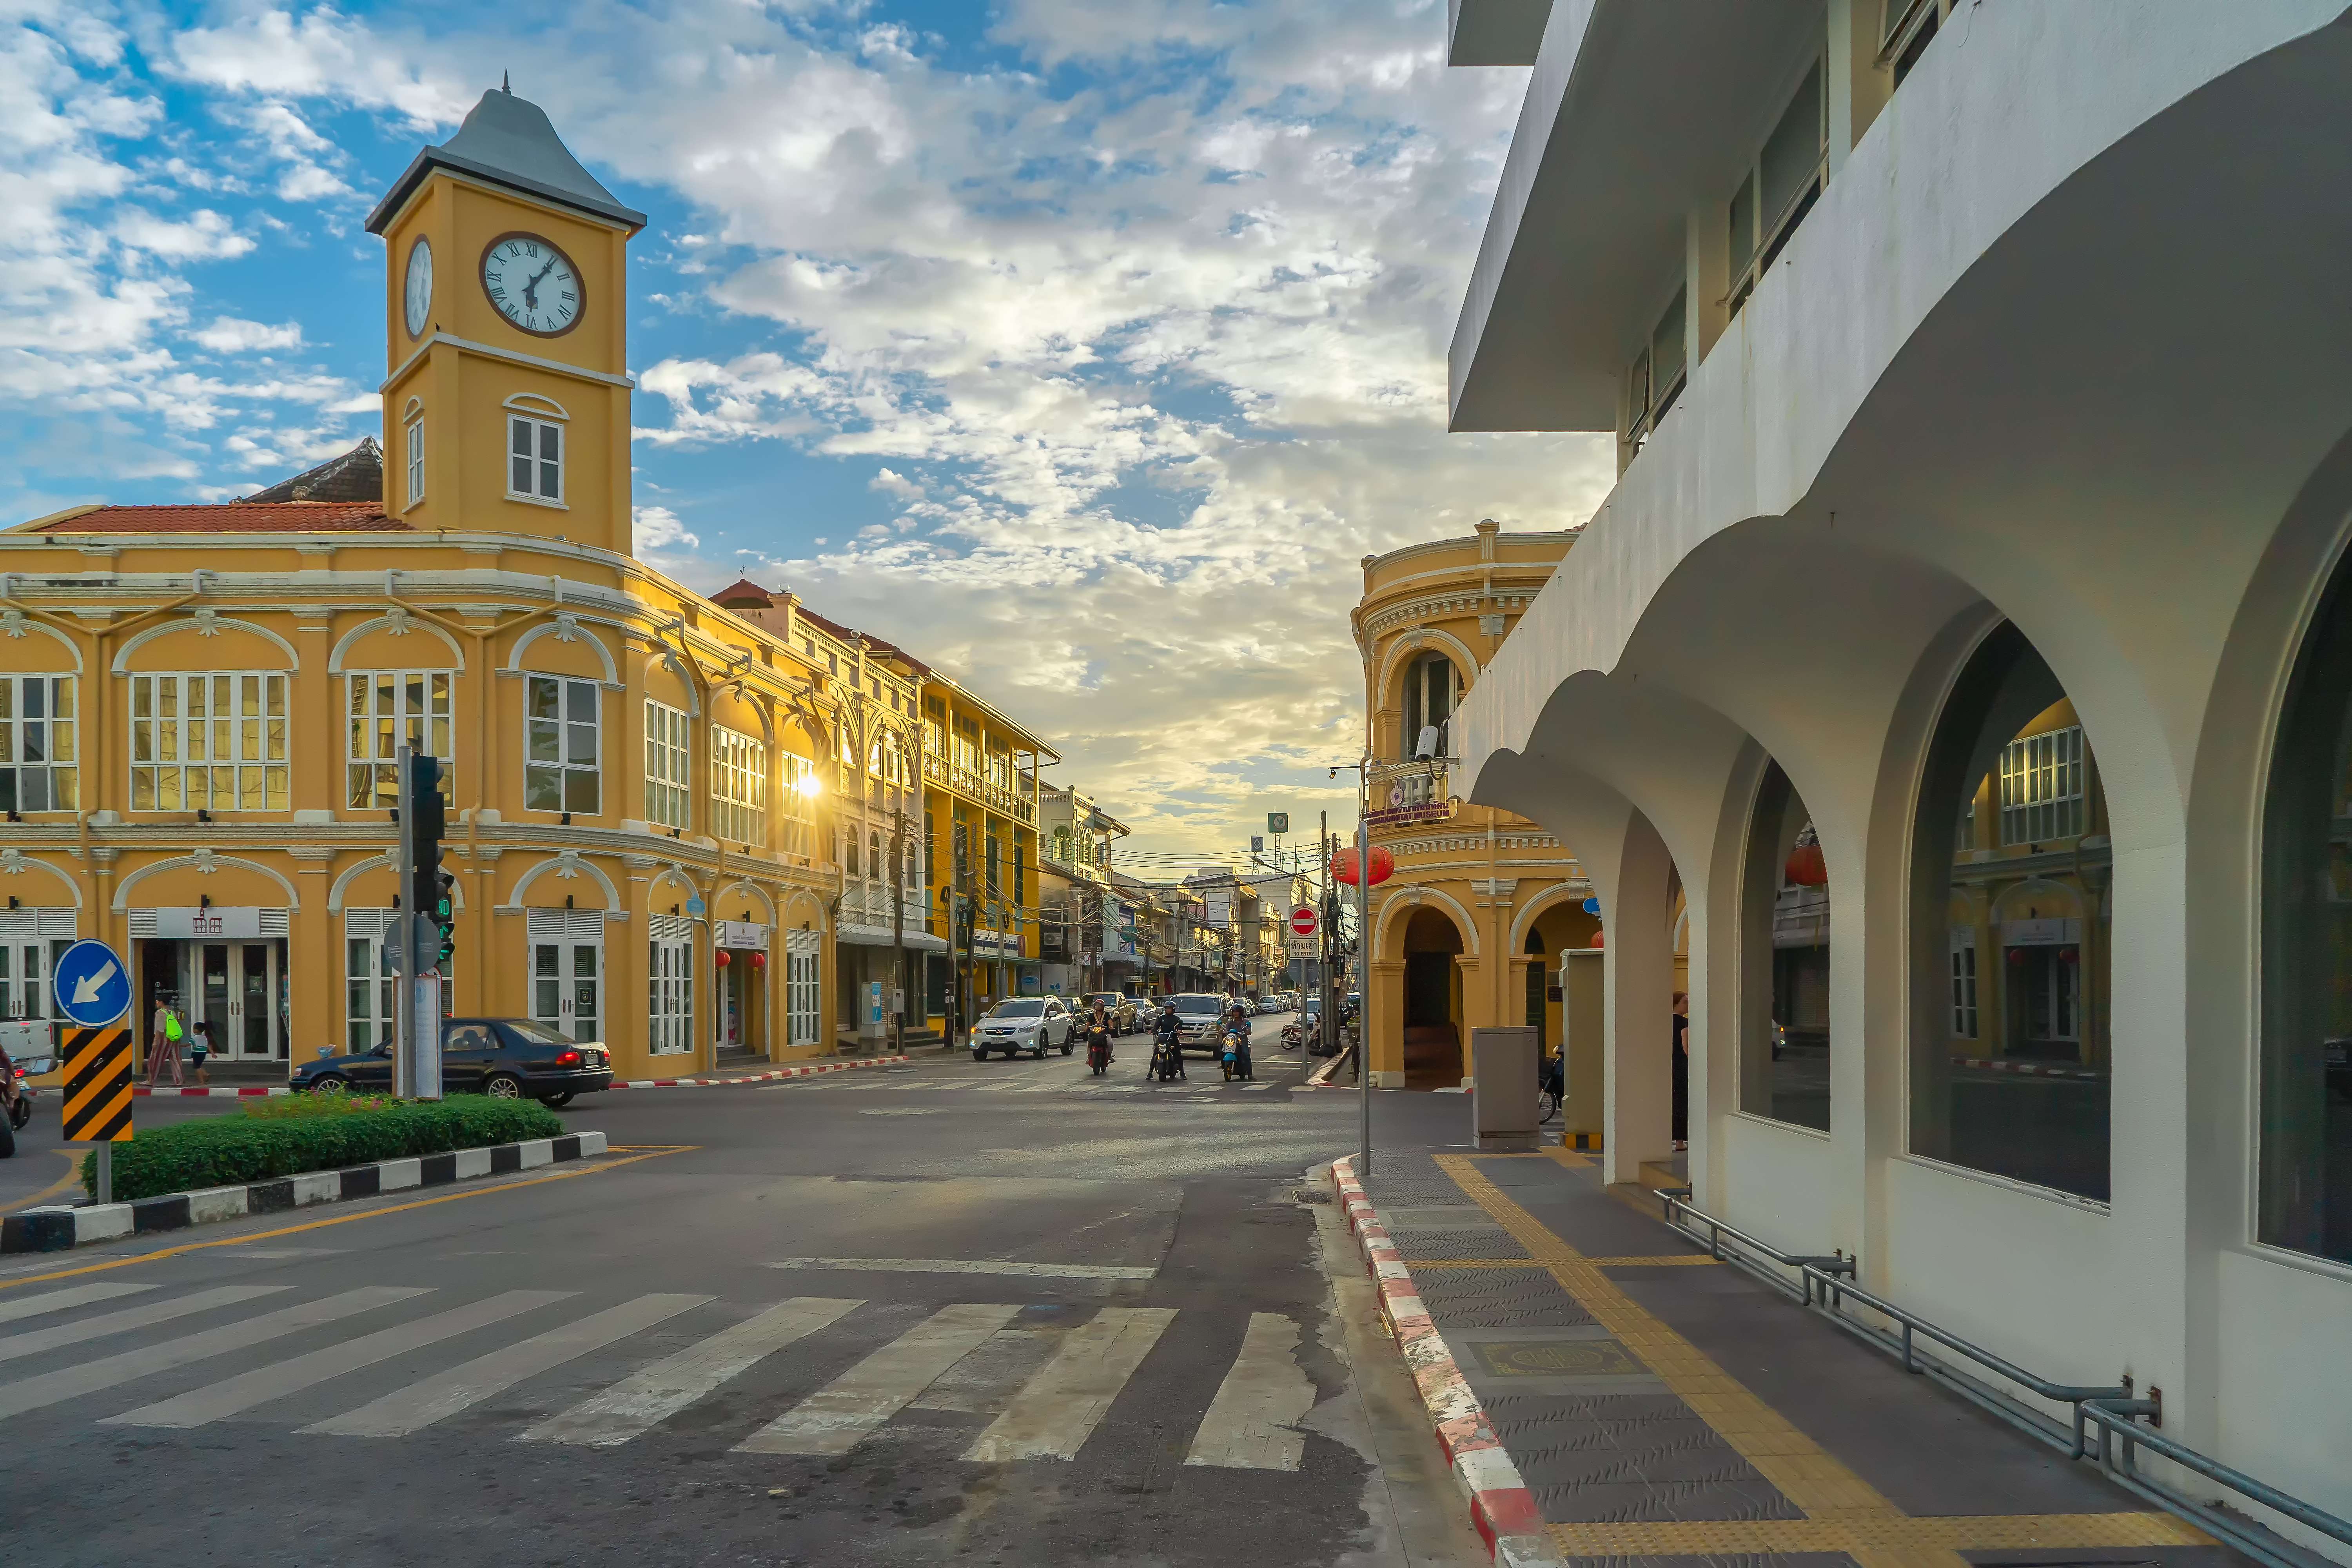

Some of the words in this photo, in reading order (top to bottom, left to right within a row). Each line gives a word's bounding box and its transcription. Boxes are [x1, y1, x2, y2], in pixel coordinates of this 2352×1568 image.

[505, 242, 521, 258] XI
[525, 242, 539, 259] XII
[492, 252, 507, 267] X
[487, 269, 501, 283] IX
[556, 273, 571, 282] II
[489, 286, 507, 305] VIII
[561, 290, 575, 302] III
[502, 302, 519, 321] VII
[557, 304, 572, 321] IV
[525, 314, 538, 330] VI
[546, 315, 557, 330] V
[1414, 809, 1450, 819] MUSEUM
[439, 900, 449, 915] 10
[1291, 940, 1317, 949] ห้ามเข้า
